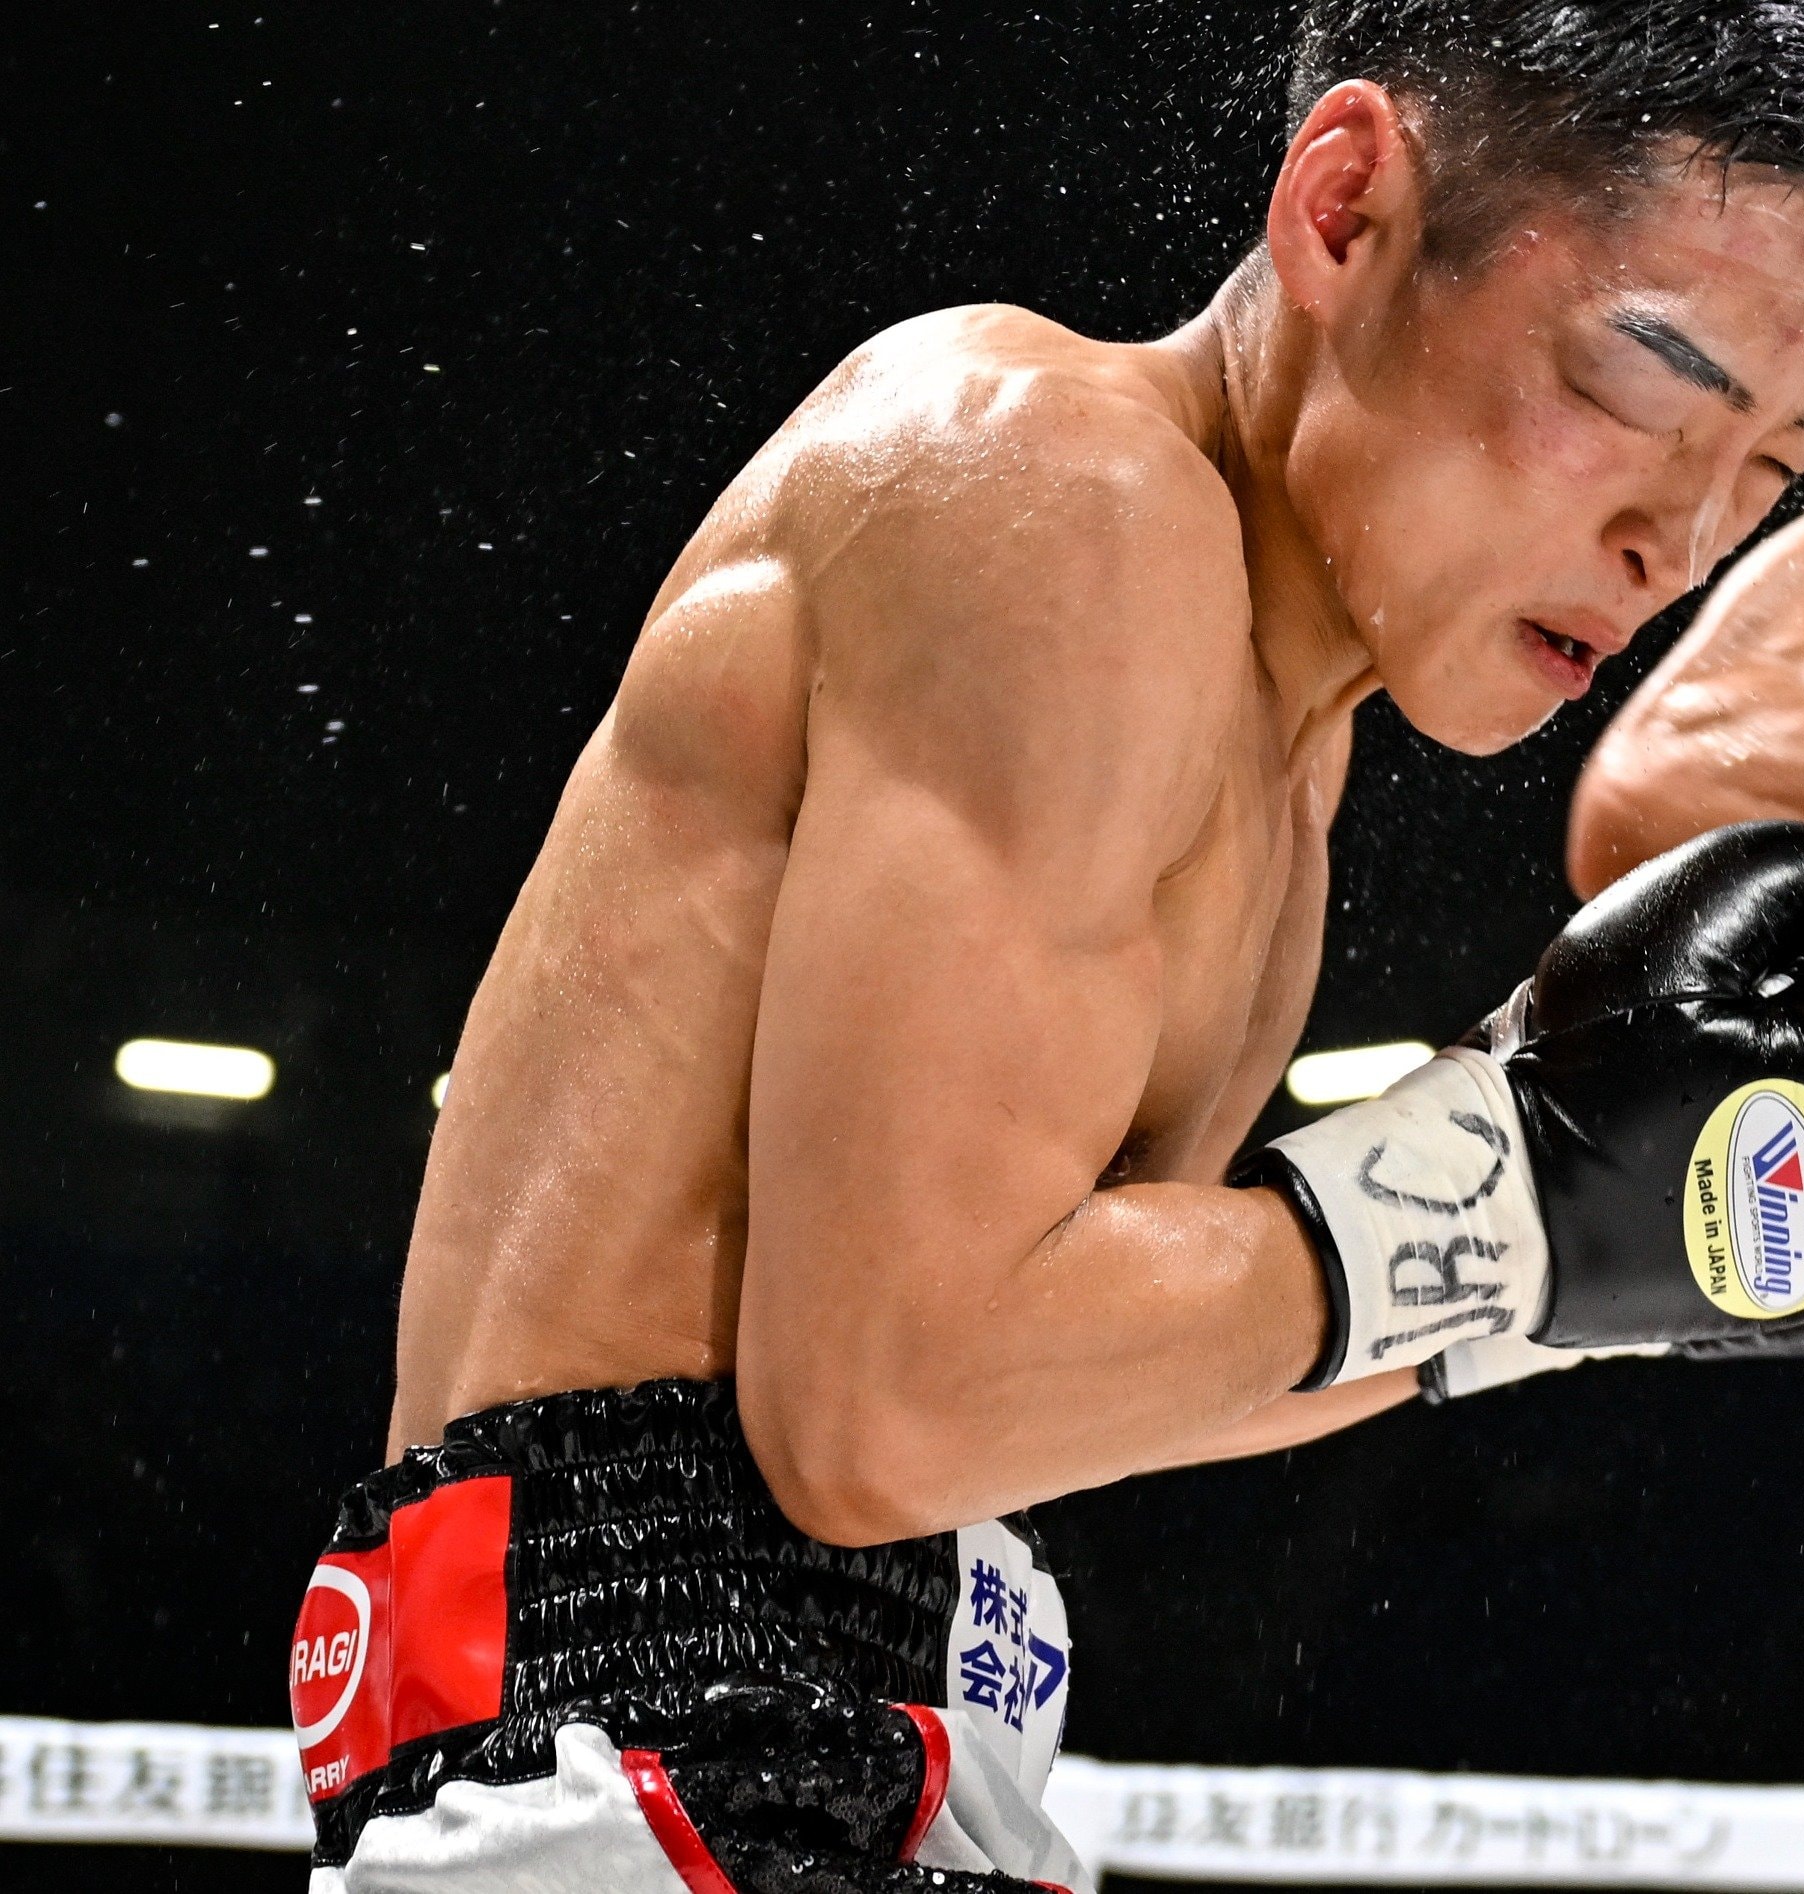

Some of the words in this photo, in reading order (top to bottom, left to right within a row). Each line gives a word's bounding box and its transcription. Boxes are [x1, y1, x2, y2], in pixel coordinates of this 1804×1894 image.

[1694, 1157, 1716, 1216] Made
[1741, 1156, 1757, 1204] FIGHTING
[1749, 1207, 1761, 1243] SPORTS
[1752, 1119, 1804, 1295] Winning
[1704, 1219, 1722, 1239] in
[1708, 1244, 1727, 1295] JAPAN
